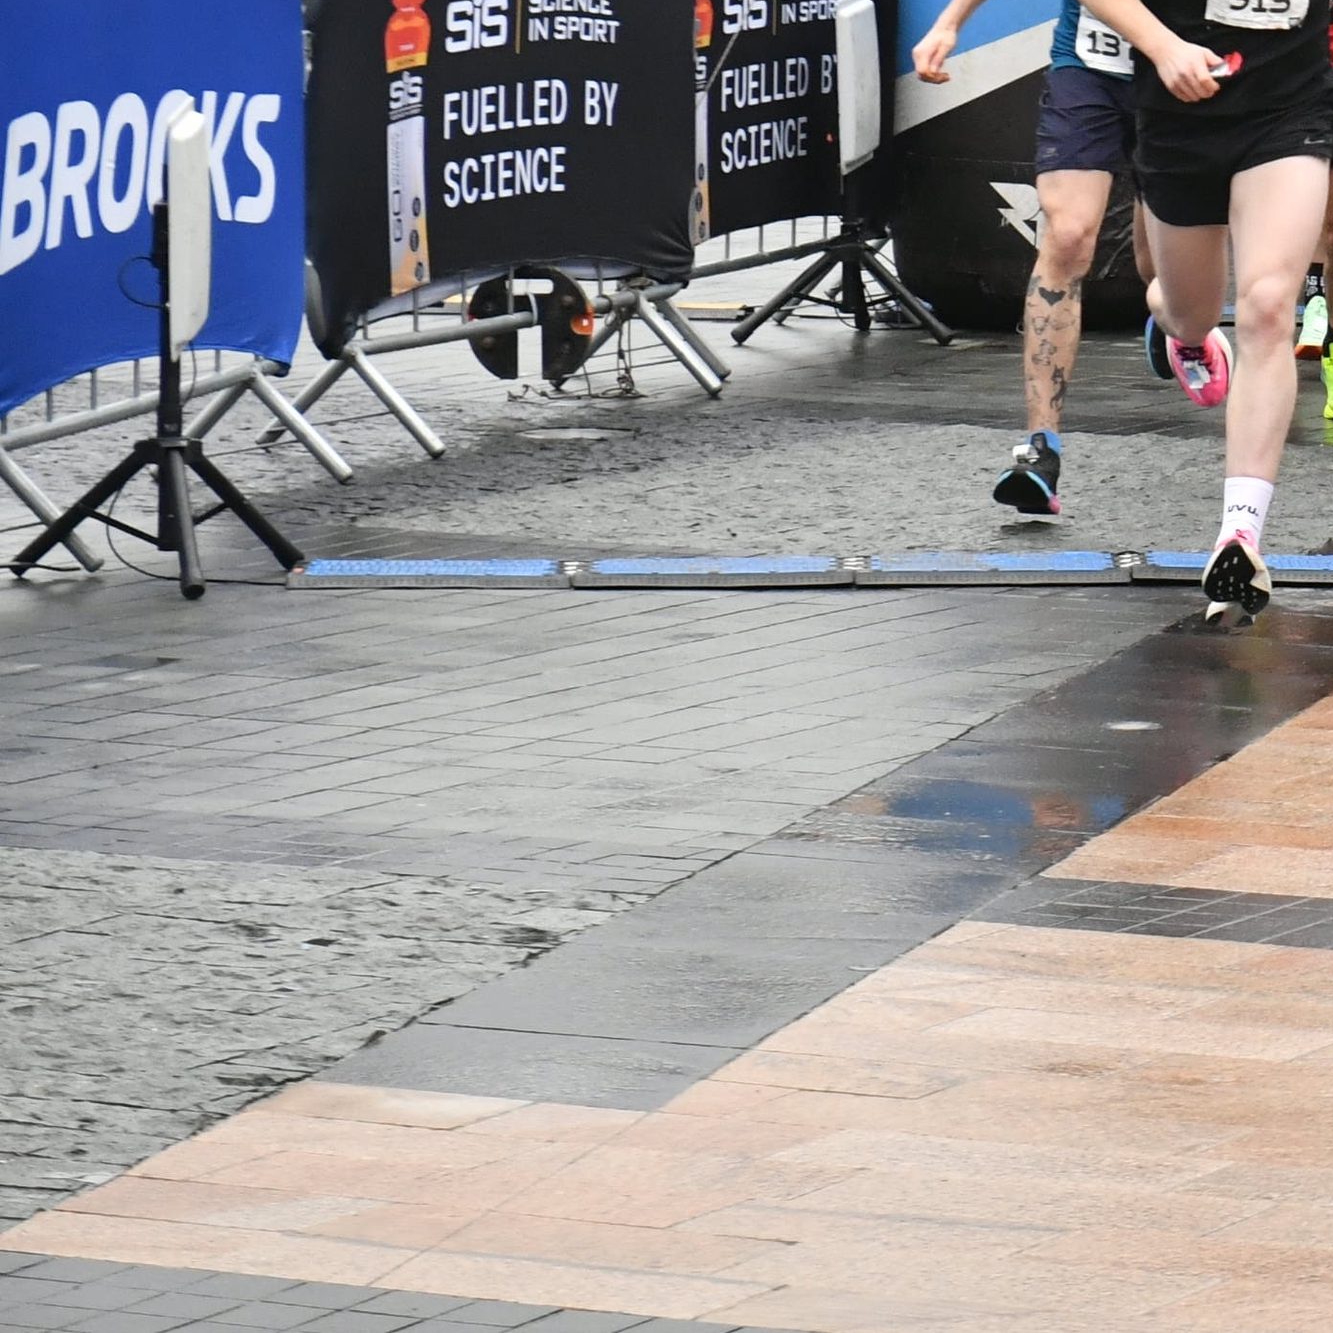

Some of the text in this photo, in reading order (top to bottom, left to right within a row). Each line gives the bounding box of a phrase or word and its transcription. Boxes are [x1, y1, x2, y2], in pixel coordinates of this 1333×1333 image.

[528, 16, 620, 44] IN SPORT
[781, 2, 797, 25] IN
[443, 78, 619, 140] FUELLED BY
[720, 56, 809, 112] FUELLED
[720, 116, 808, 174] SCIENCE
[443, 146, 566, 208] SCIENCE
